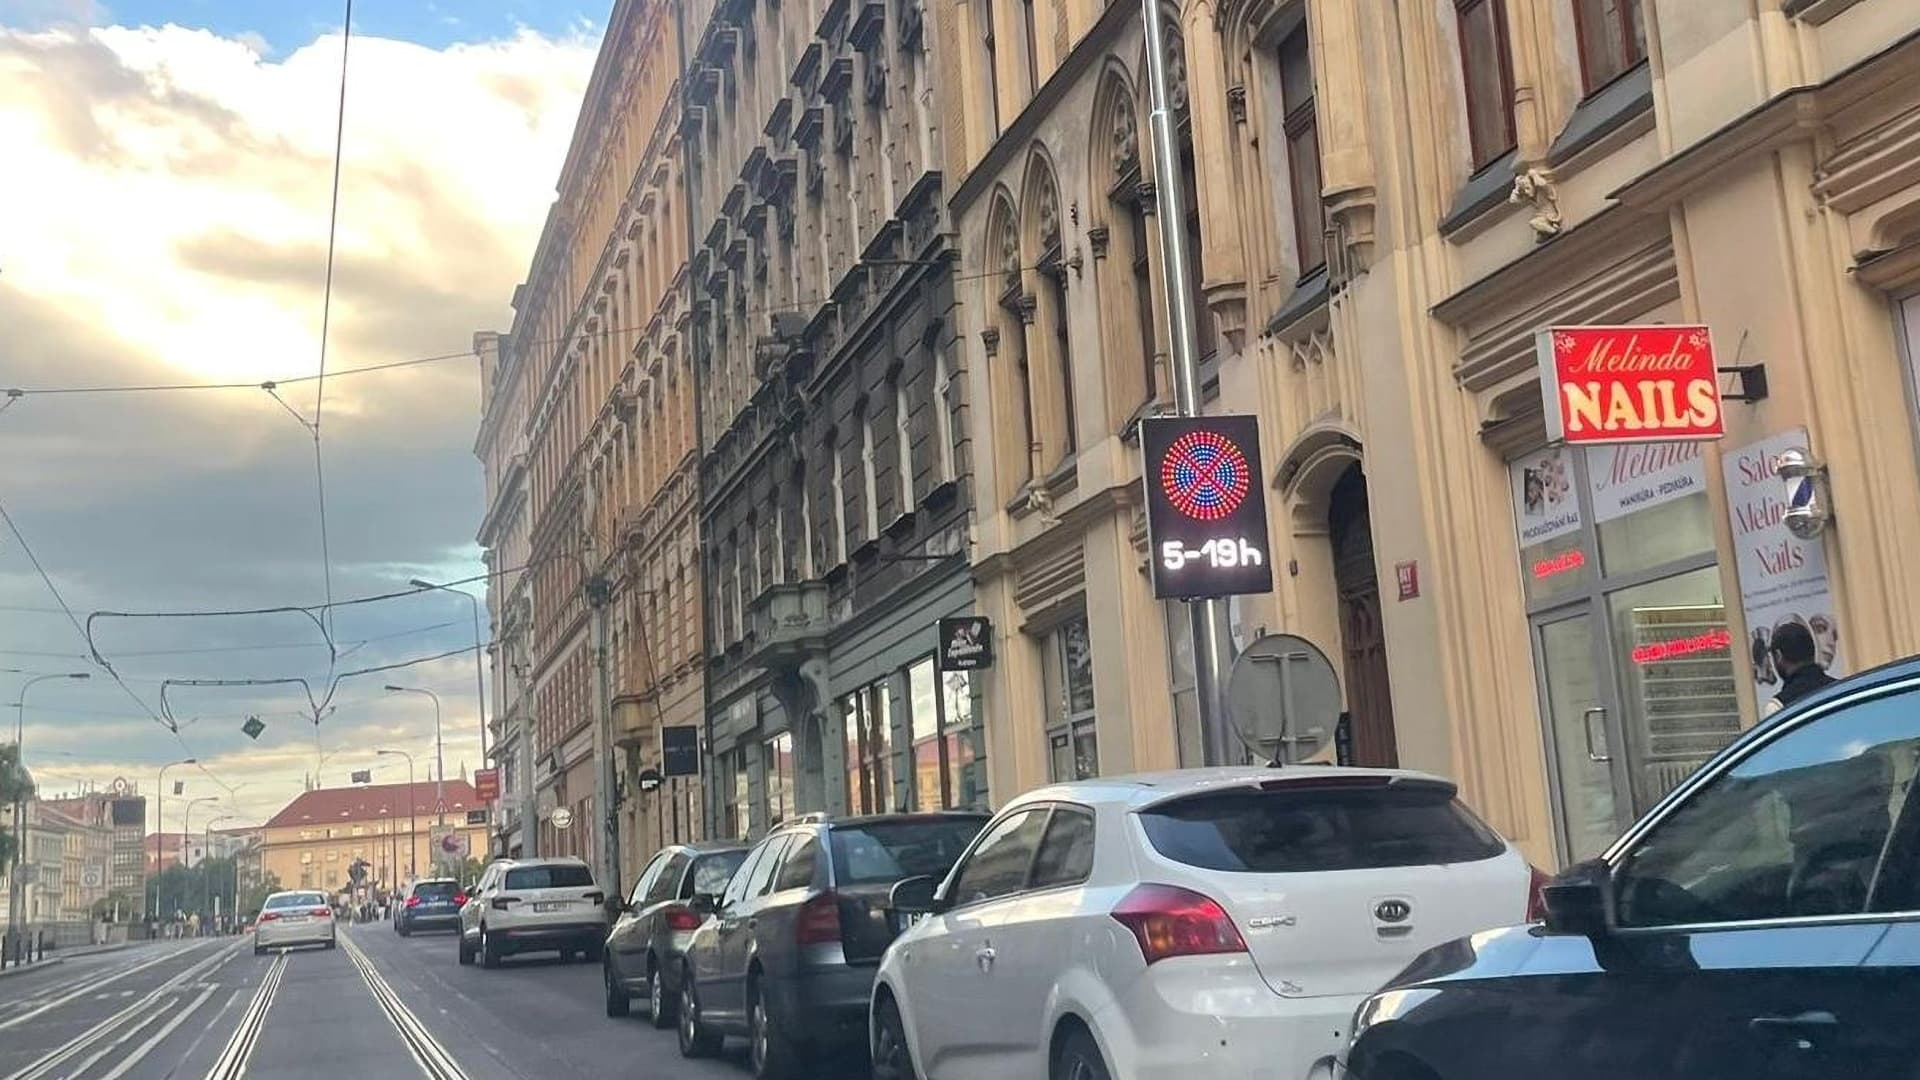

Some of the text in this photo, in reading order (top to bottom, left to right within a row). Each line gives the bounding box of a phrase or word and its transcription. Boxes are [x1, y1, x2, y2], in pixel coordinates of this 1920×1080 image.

[1569, 334, 1693, 373] Melinda
[1562, 379, 1718, 432] NAILS
[1738, 450, 1784, 487] Salo
[1736, 496, 1786, 535] Melin
[1163, 538, 1262, 570] 5-19h
[1755, 539, 1805, 578] Nails
